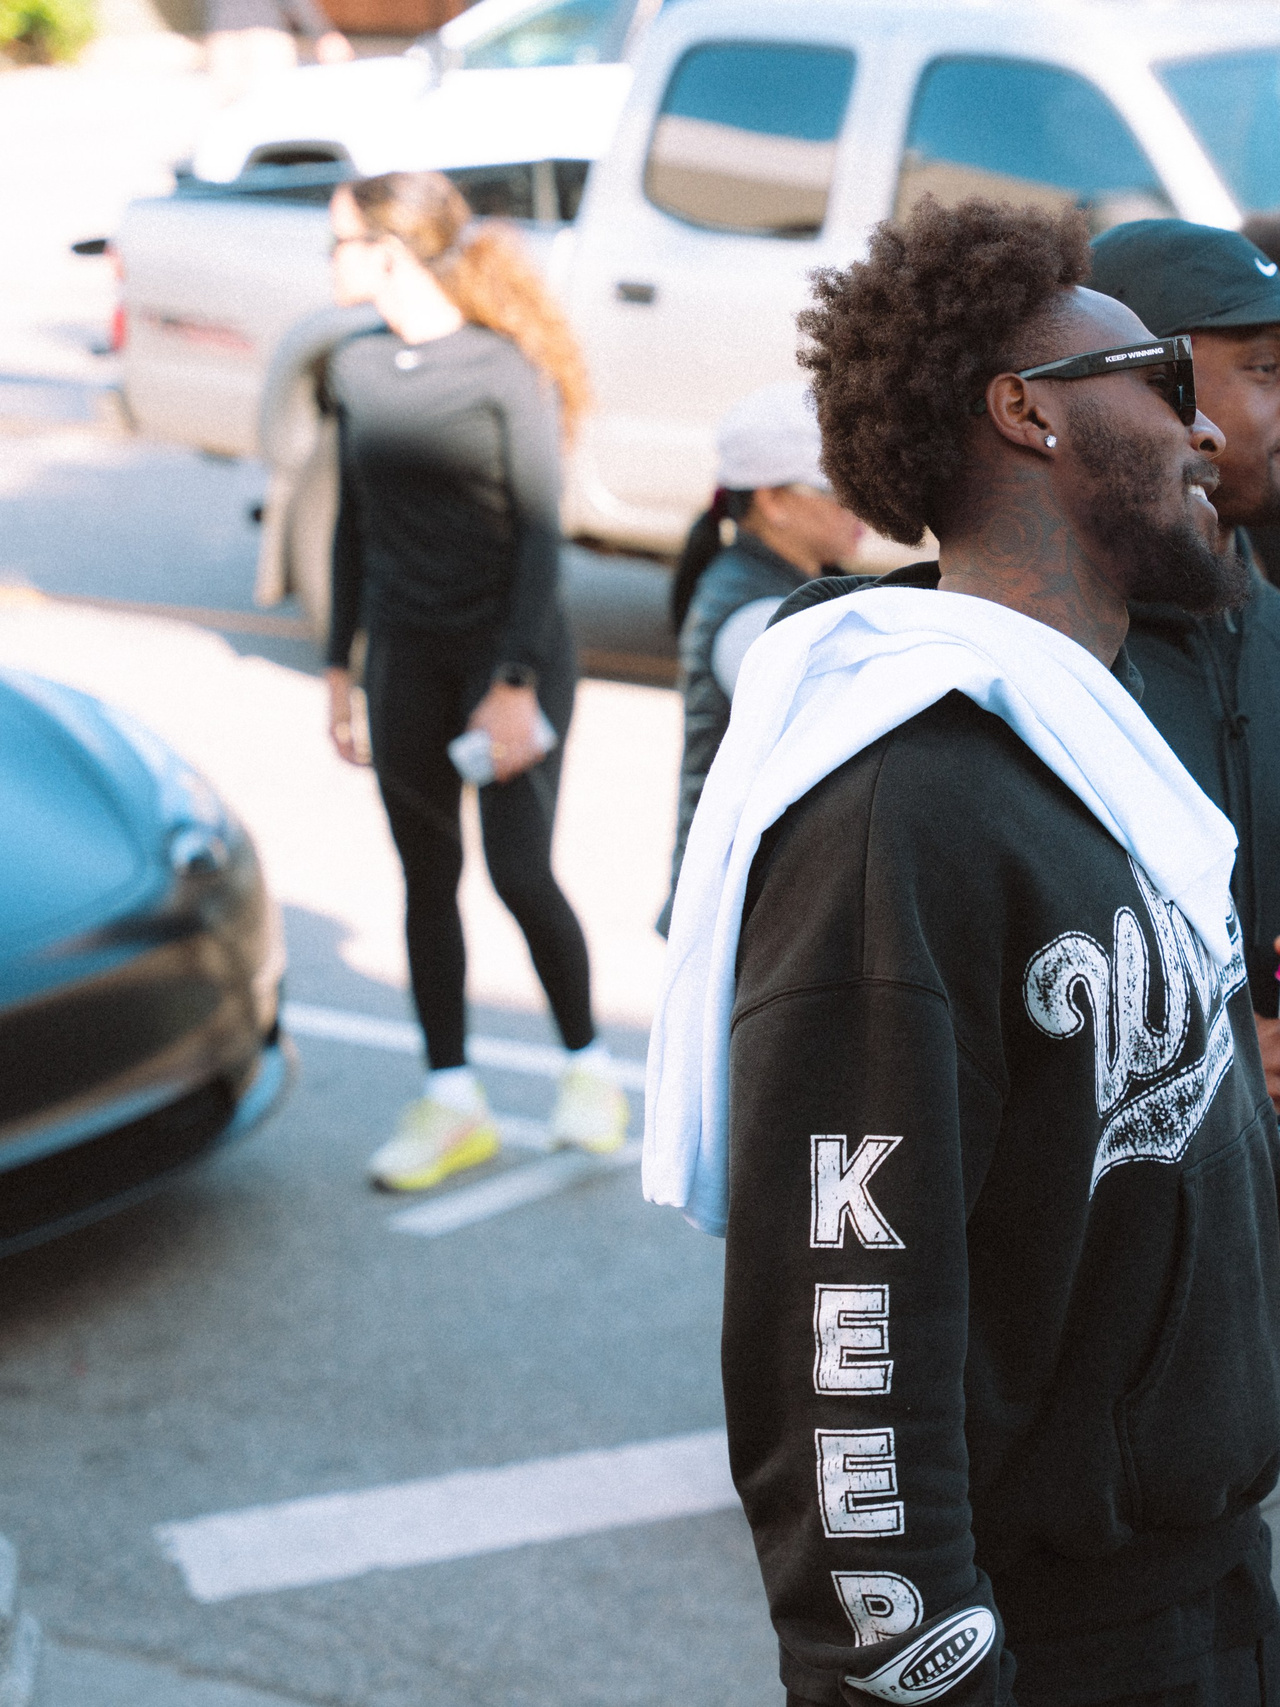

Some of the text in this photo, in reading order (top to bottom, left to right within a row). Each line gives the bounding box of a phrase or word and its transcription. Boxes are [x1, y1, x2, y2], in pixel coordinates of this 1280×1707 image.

[1105, 347, 1164, 363] KEEP WINNING
[810, 1135, 924, 1648] KEEP
[903, 1629, 975, 1688] WINNING
